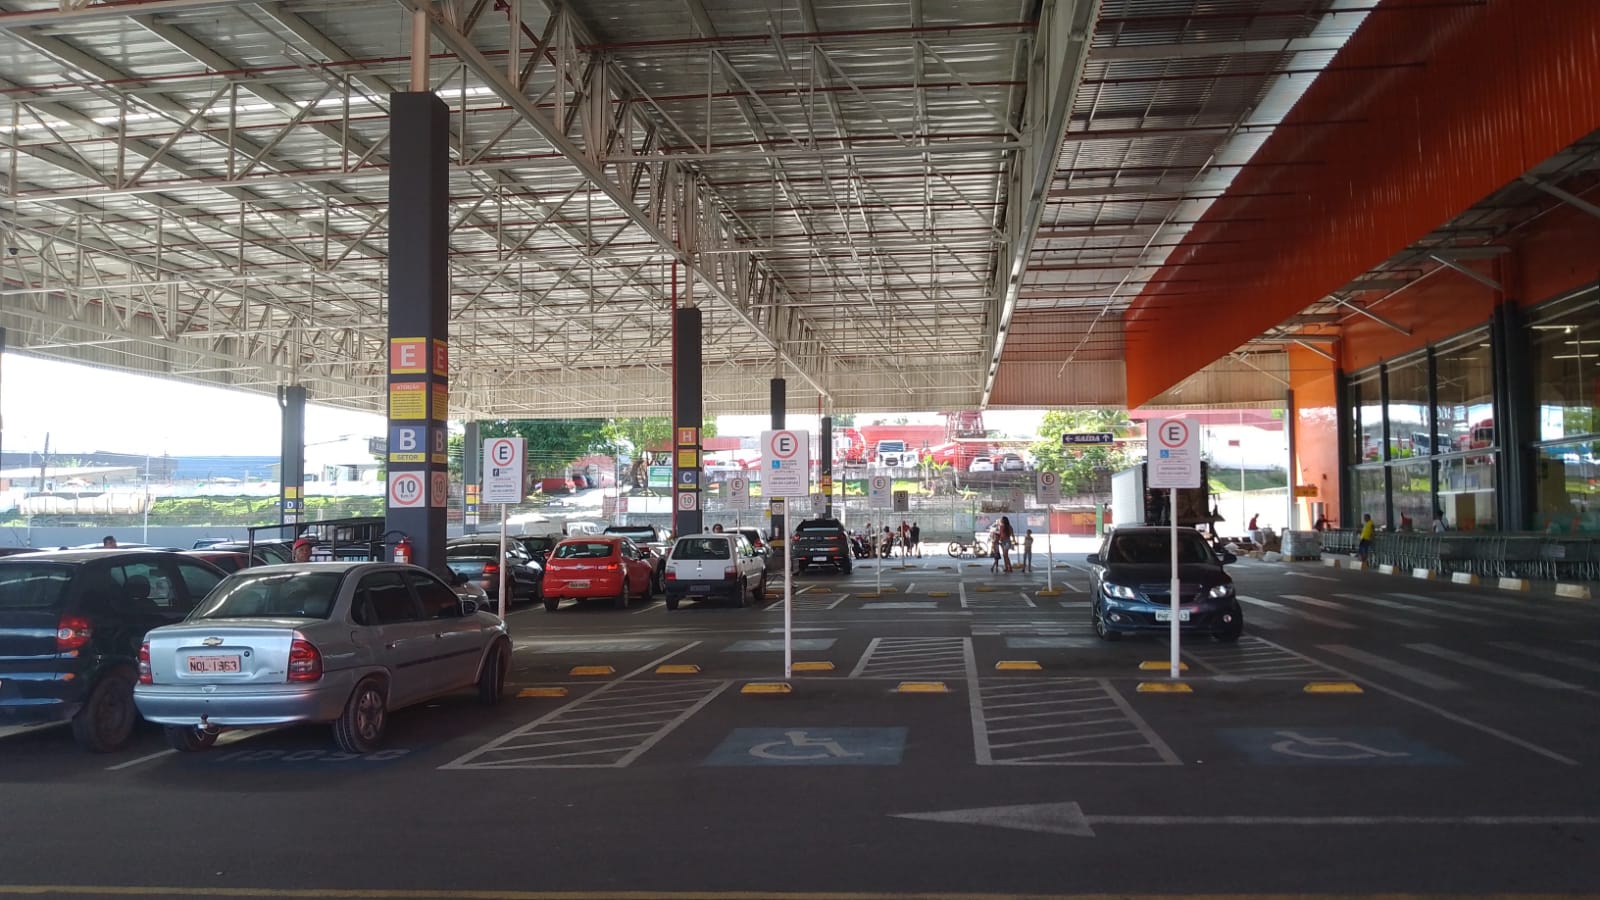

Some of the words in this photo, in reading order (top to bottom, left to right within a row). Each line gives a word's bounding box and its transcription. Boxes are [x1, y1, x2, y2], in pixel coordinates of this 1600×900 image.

[401, 344, 416, 366] E
[437, 347, 444, 369] E
[400, 429, 416, 450] B
[682, 431, 692, 442] H
[1169, 426, 1180, 441] E
[436, 430, 444, 451] B
[780, 437, 790, 451] E
[500, 446, 508, 459] E
[682, 472, 692, 483] C
[398, 480, 416, 493] 10
[435, 480, 443, 493] 10
[287, 501, 294, 509] D
[683, 496, 692, 504] 10
